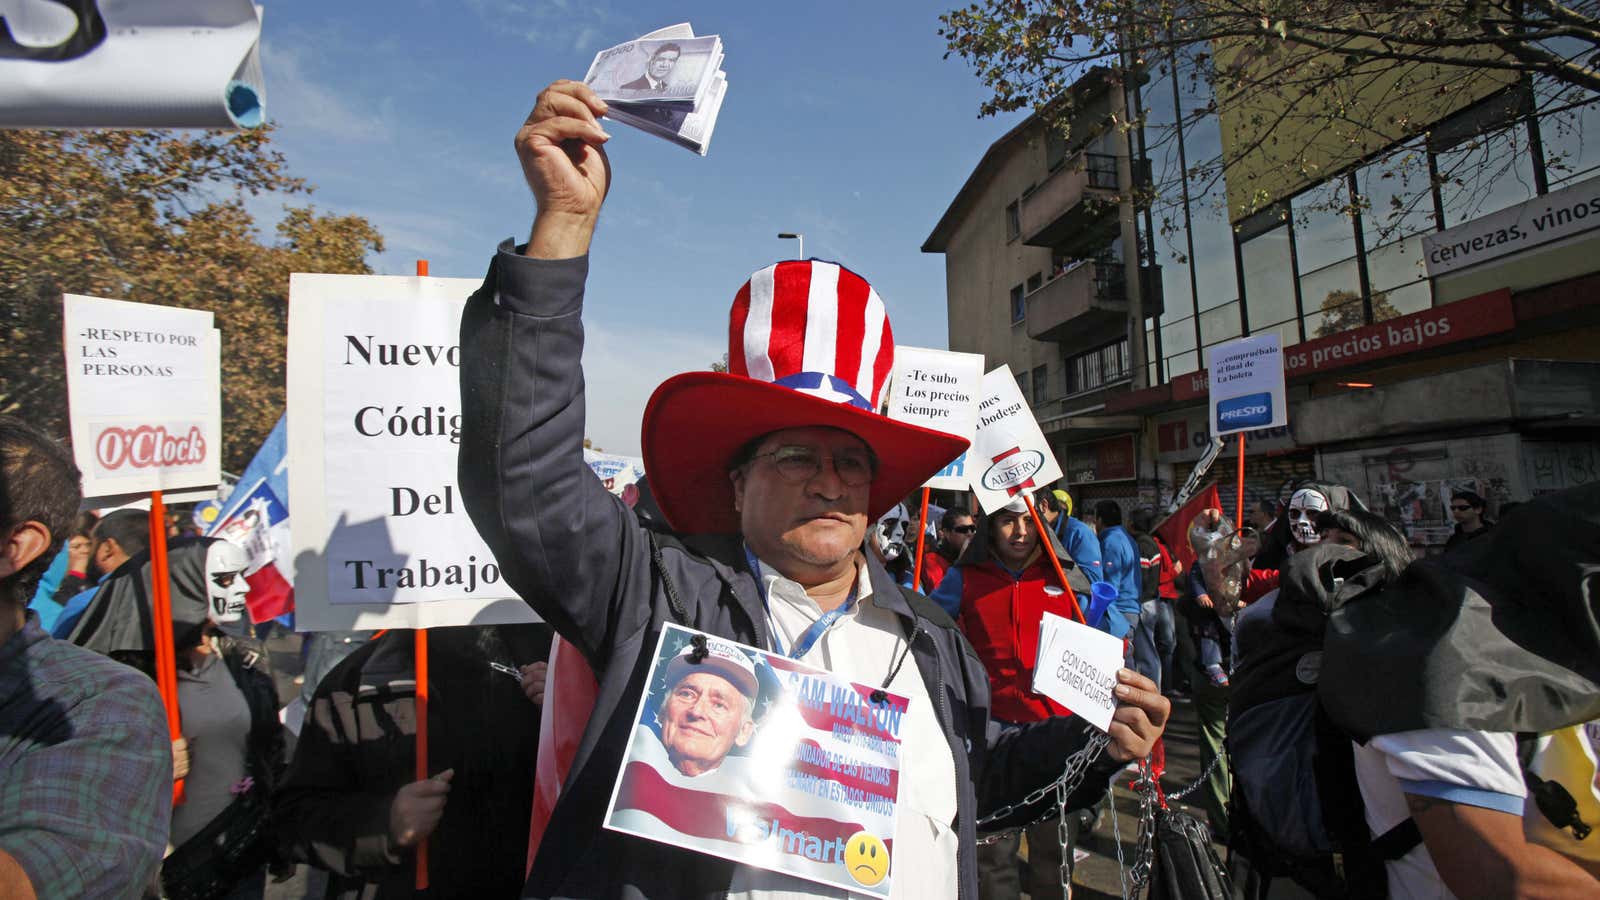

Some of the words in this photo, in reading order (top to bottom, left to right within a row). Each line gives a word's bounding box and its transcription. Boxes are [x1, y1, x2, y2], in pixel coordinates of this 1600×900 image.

[1430, 224, 1527, 264] cervezas,
[80, 328, 165, 344] -RESPETO
[169, 334, 197, 346] POR
[82, 346, 117, 358] LAS
[344, 335, 460, 367] Nuevo
[1312, 334, 1381, 368] precios
[1387, 317, 1450, 345] bajos
[83, 363, 174, 376] PERSONAS
[907, 370, 928, 382] -Te
[930, 372, 958, 385] subo
[1226, 362, 1243, 371] final
[1229, 372, 1253, 381] boleta
[905, 386, 927, 398] Los
[930, 391, 971, 404] precios
[354, 406, 462, 444] Códig
[903, 404, 950, 419] siempre
[981, 403, 1021, 427] bodega
[1220, 405, 1267, 420] PRESTO
[97, 426, 205, 467] O'Clock
[991, 459, 1037, 487] ALISERV
[389, 486, 455, 516] Del
[345, 555, 500, 593] Trabajo
[1062, 649, 1080, 670] CON
[1080, 660, 1097, 681] DOS
[1056, 664, 1086, 692] COMEN
[1084, 683, 1112, 710] CUATRO
[830, 685, 903, 736] WALTON
[832, 753, 843, 772] DE
[844, 756, 858, 777] LAS
[860, 762, 891, 786] TIENDAS
[818, 779, 831, 799] EN
[831, 783, 865, 808] ESTADOS
[865, 792, 894, 816] UNIDOS
